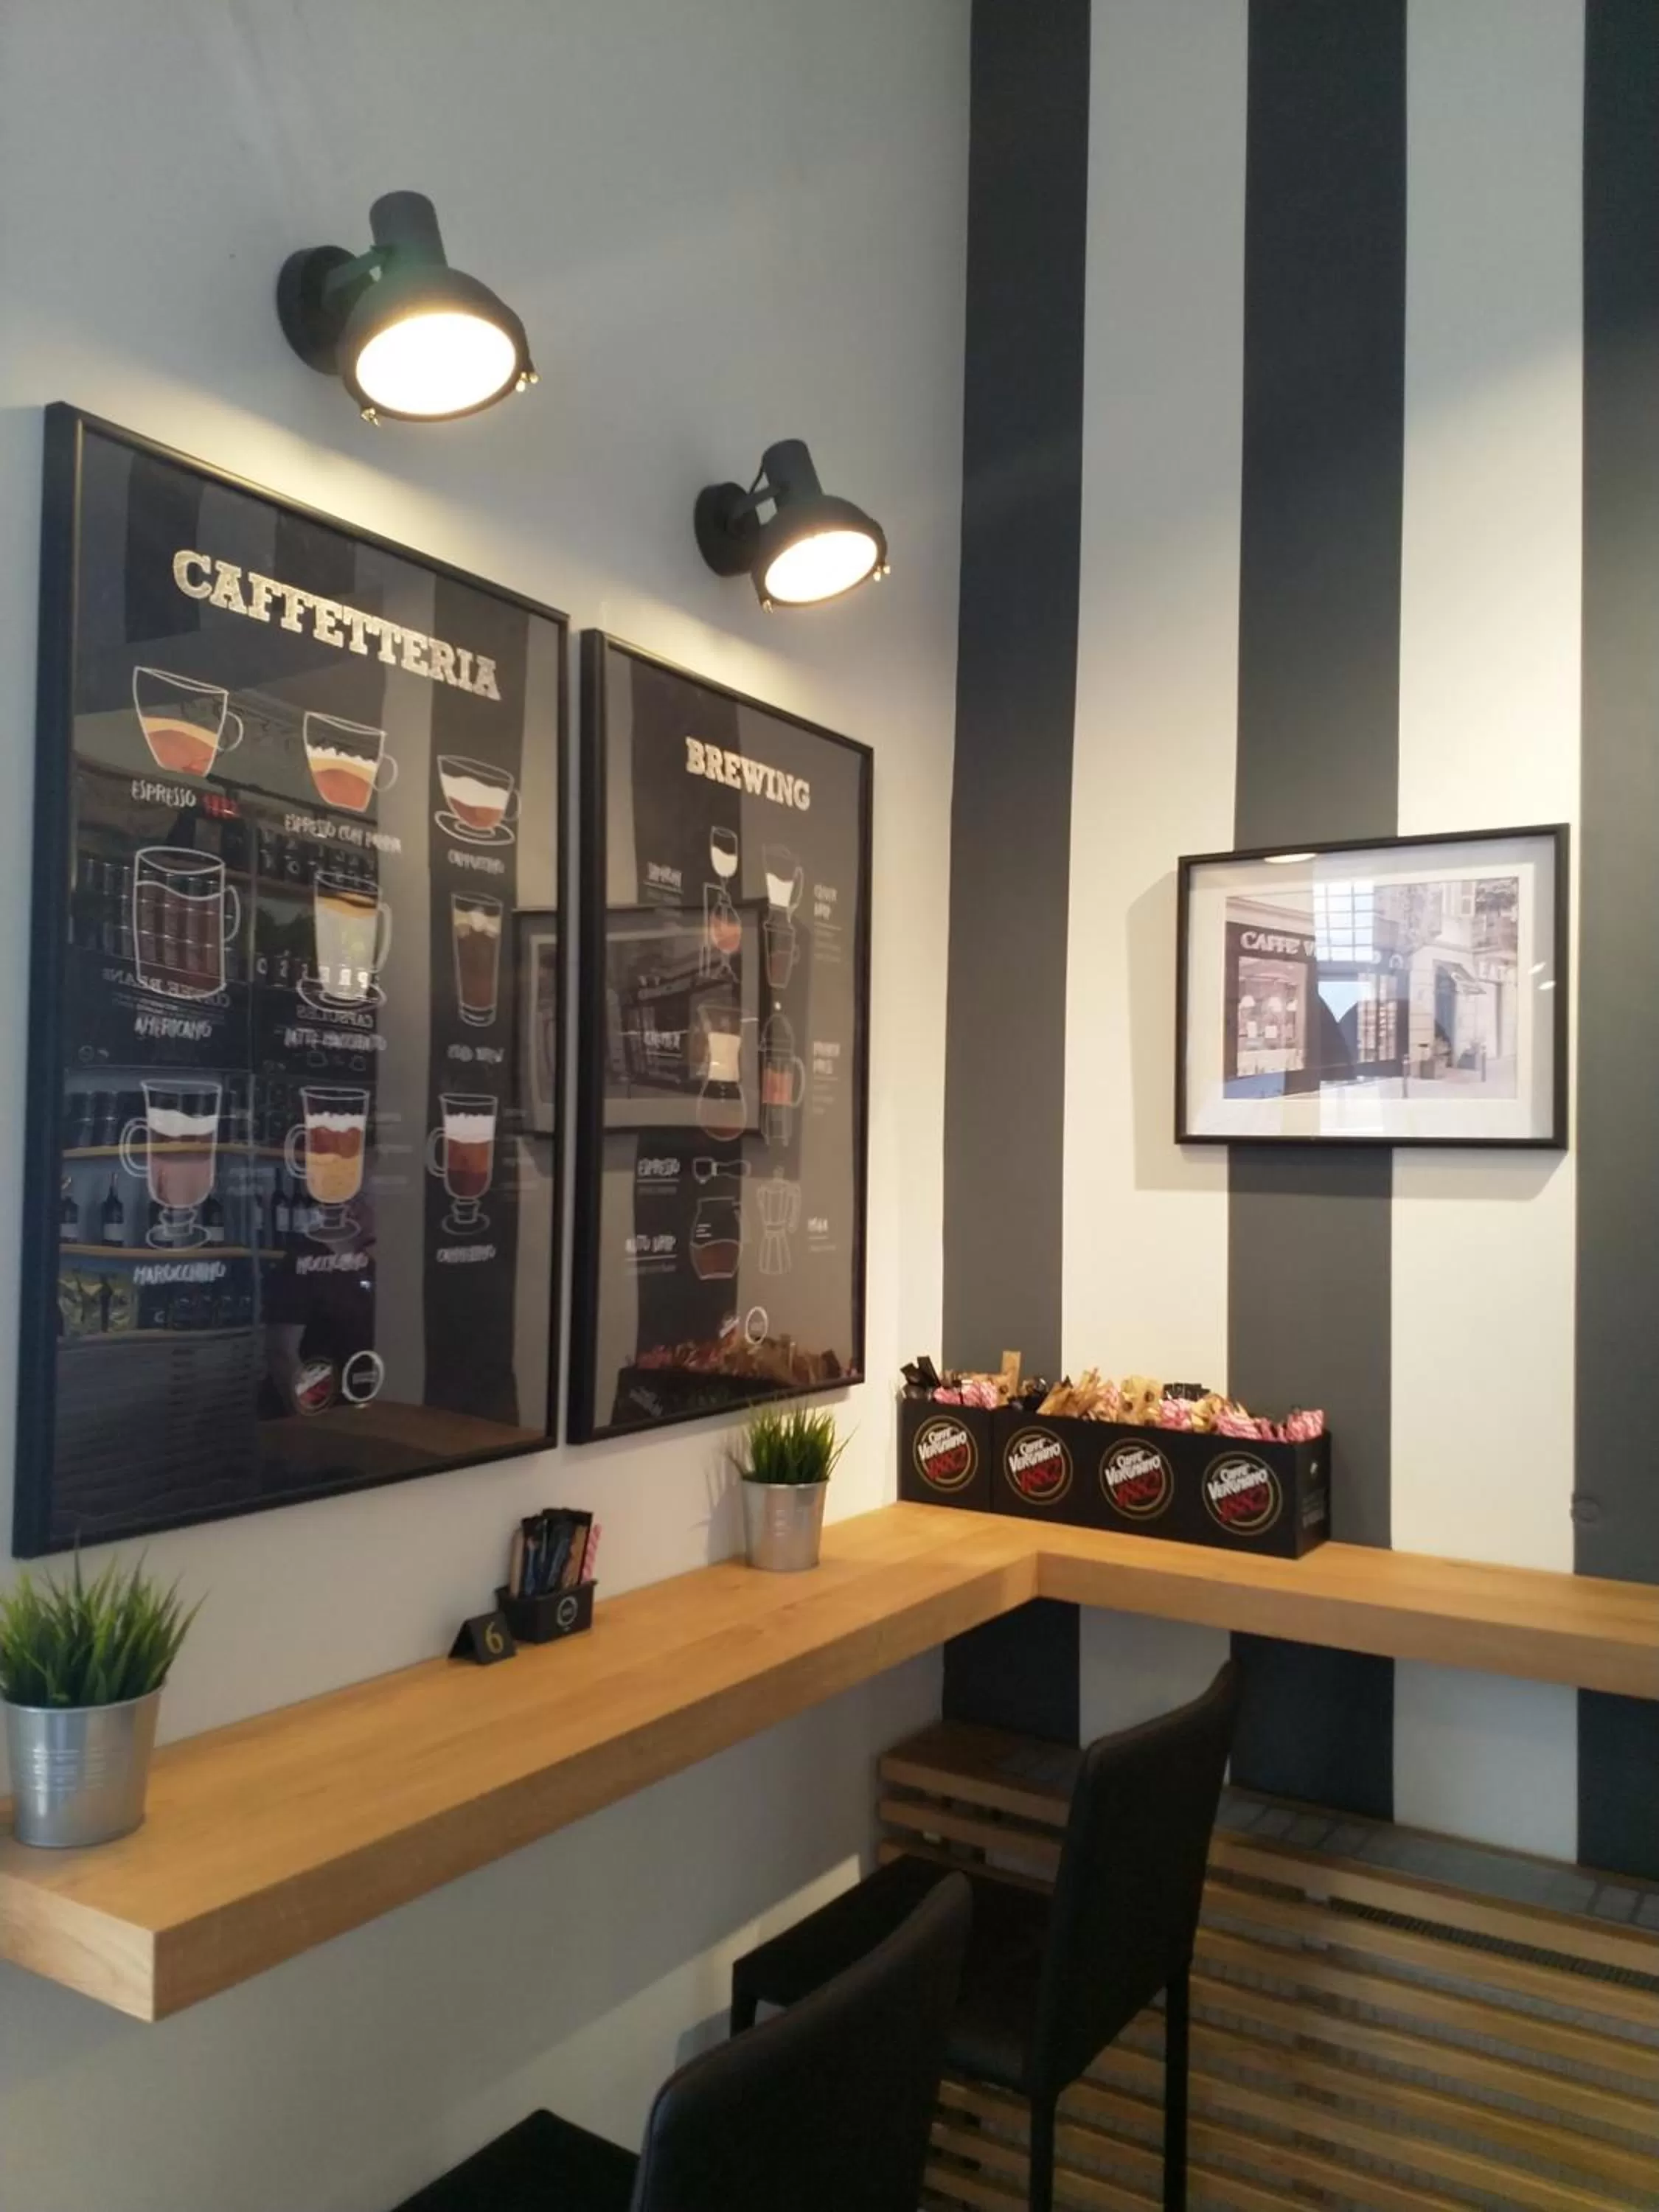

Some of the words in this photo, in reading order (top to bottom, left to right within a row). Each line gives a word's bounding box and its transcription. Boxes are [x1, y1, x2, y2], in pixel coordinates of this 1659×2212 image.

[173, 550, 501, 700] CAFFETTERIA
[131, 779, 197, 807] ESPRESSO
[686, 737, 810, 811] BREWING
[485, 1621, 504, 1653] 6
